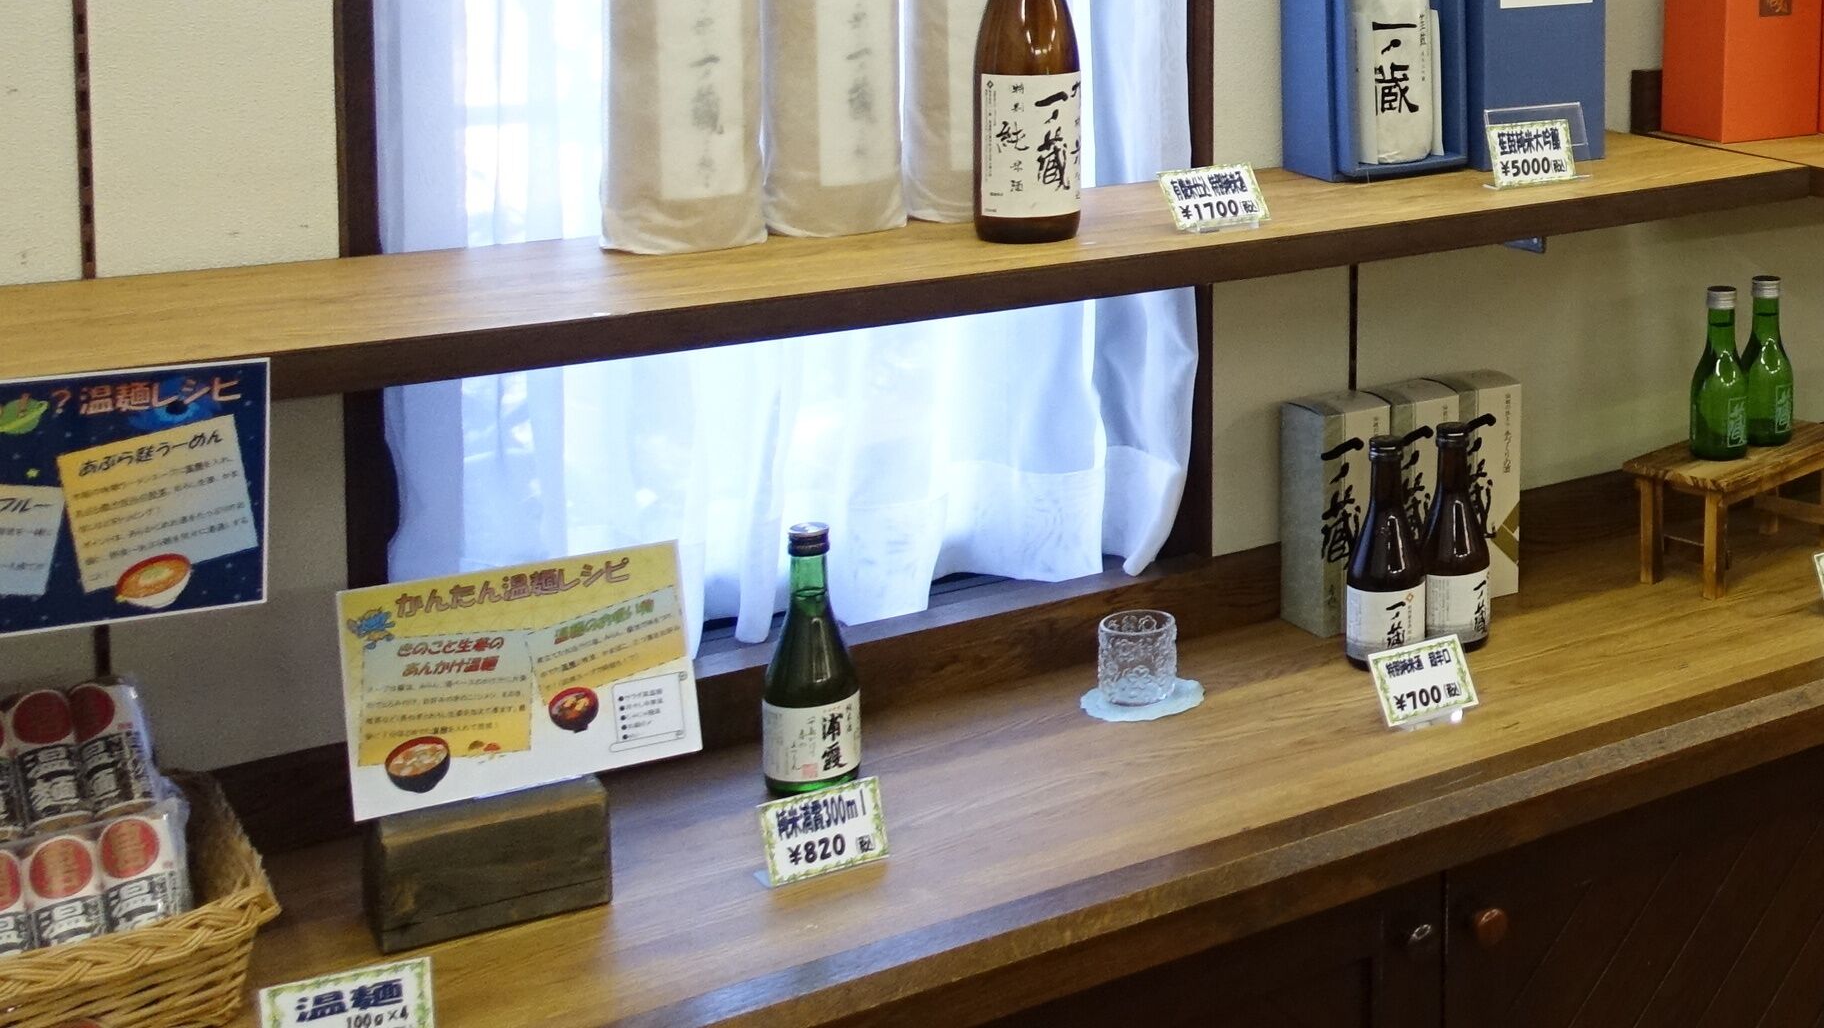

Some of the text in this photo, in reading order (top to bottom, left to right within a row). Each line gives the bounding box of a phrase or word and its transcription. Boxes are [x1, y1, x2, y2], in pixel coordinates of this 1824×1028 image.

[1372, 21, 1419, 116] 一ノ蔵
[996, 83, 1030, 193] 特別純米酒
[1035, 91, 1070, 192] 一ノ蔵
[1500, 157, 1550, 177] ¥5000
[1179, 199, 1239, 220] ¥1700
[395, 556, 630, 619] かんたん温麺レシピ
[397, 636, 505, 658] きのこと生姜の
[402, 656, 500, 678] あんかけ温麺
[1394, 686, 1442, 712] ¥700
[821, 712, 848, 772] 浦霞
[787, 834, 846, 866] ¥820
[296, 977, 404, 1023] 温麺
